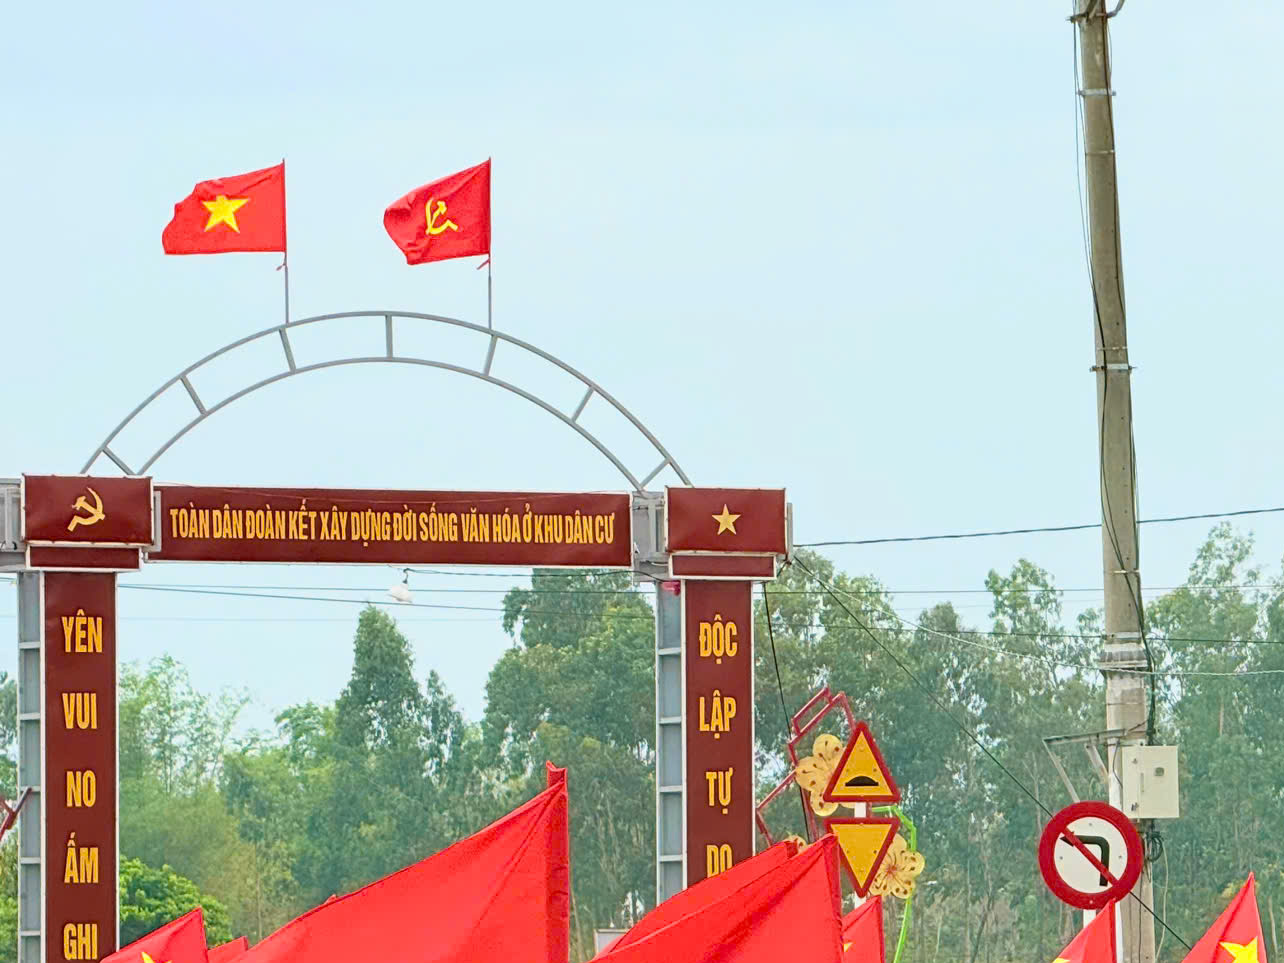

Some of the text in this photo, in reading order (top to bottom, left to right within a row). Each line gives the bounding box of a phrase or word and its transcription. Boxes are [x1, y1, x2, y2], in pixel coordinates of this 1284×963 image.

[170, 498, 615, 547] TOÀN DÂN ĐOÀN KẾT XÂY DỰNG ĐỜI SỐNG VĂN HÓA Ở KHU DÂN CƯ
[62, 609, 103, 653] YÊN
[62, 692, 98, 730] VUI
[699, 614, 738, 879] ĐỘC LẬP TỰ DO
[66, 770, 96, 808] NO
[64, 832, 99, 884] ẤM
[63, 923, 98, 961] GHI
